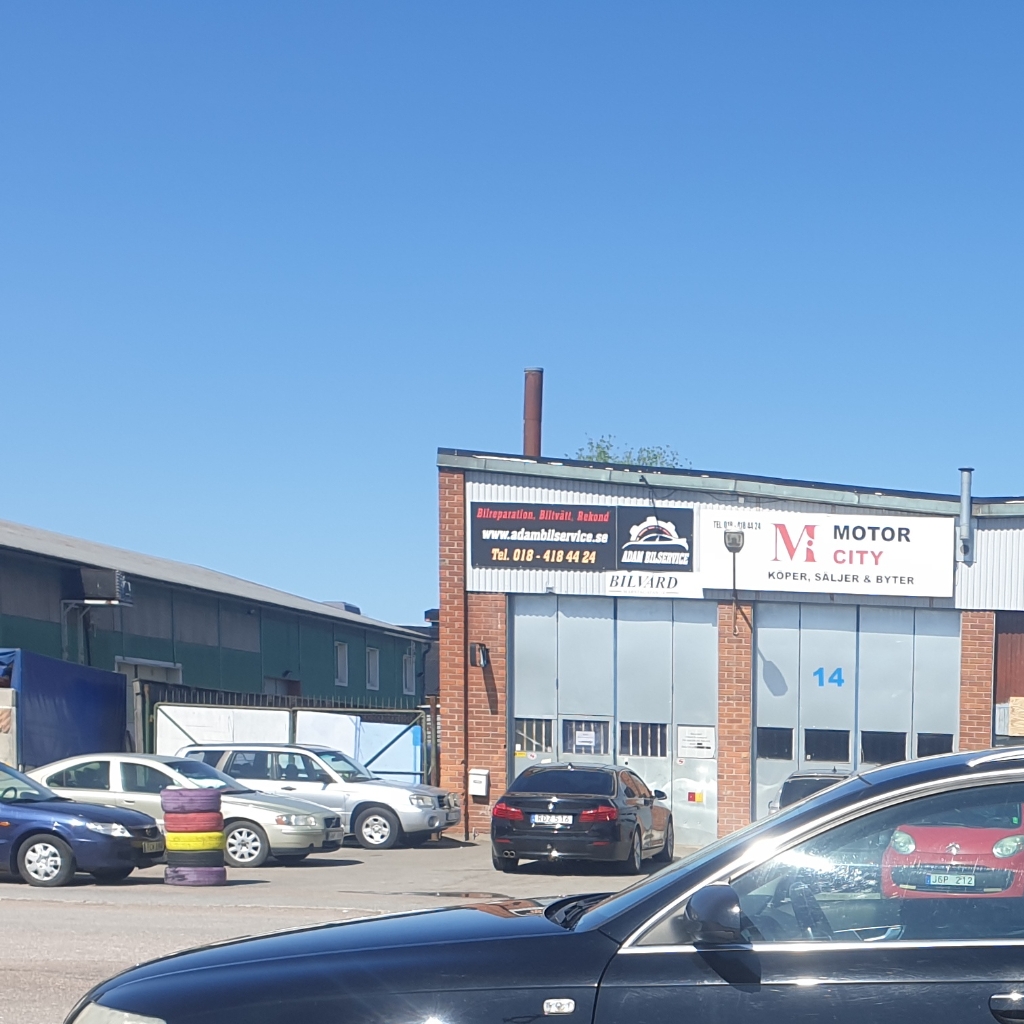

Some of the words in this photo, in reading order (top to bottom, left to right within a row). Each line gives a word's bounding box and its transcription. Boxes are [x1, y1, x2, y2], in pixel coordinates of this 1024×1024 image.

[577, 510, 610, 522] Rekond
[482, 527, 609, 543] www.adambilservice.se
[833, 524, 911, 543] MOTOR
[491, 548, 510, 561] Tel.
[513, 548, 535, 562] 018
[543, 549, 564, 563] 418
[565, 550, 580, 563] 44
[581, 550, 597, 564] 24
[621, 550, 645, 563] ADAM
[644, 551, 690, 565] BILSERVICE
[833, 549, 884, 566] CITY
[814, 571, 860, 583] SÄLJER
[863, 575, 872, 583] &
[876, 575, 914, 585] BYTER
[812, 667, 845, 687] 14
[955, 876, 973, 885] 212
